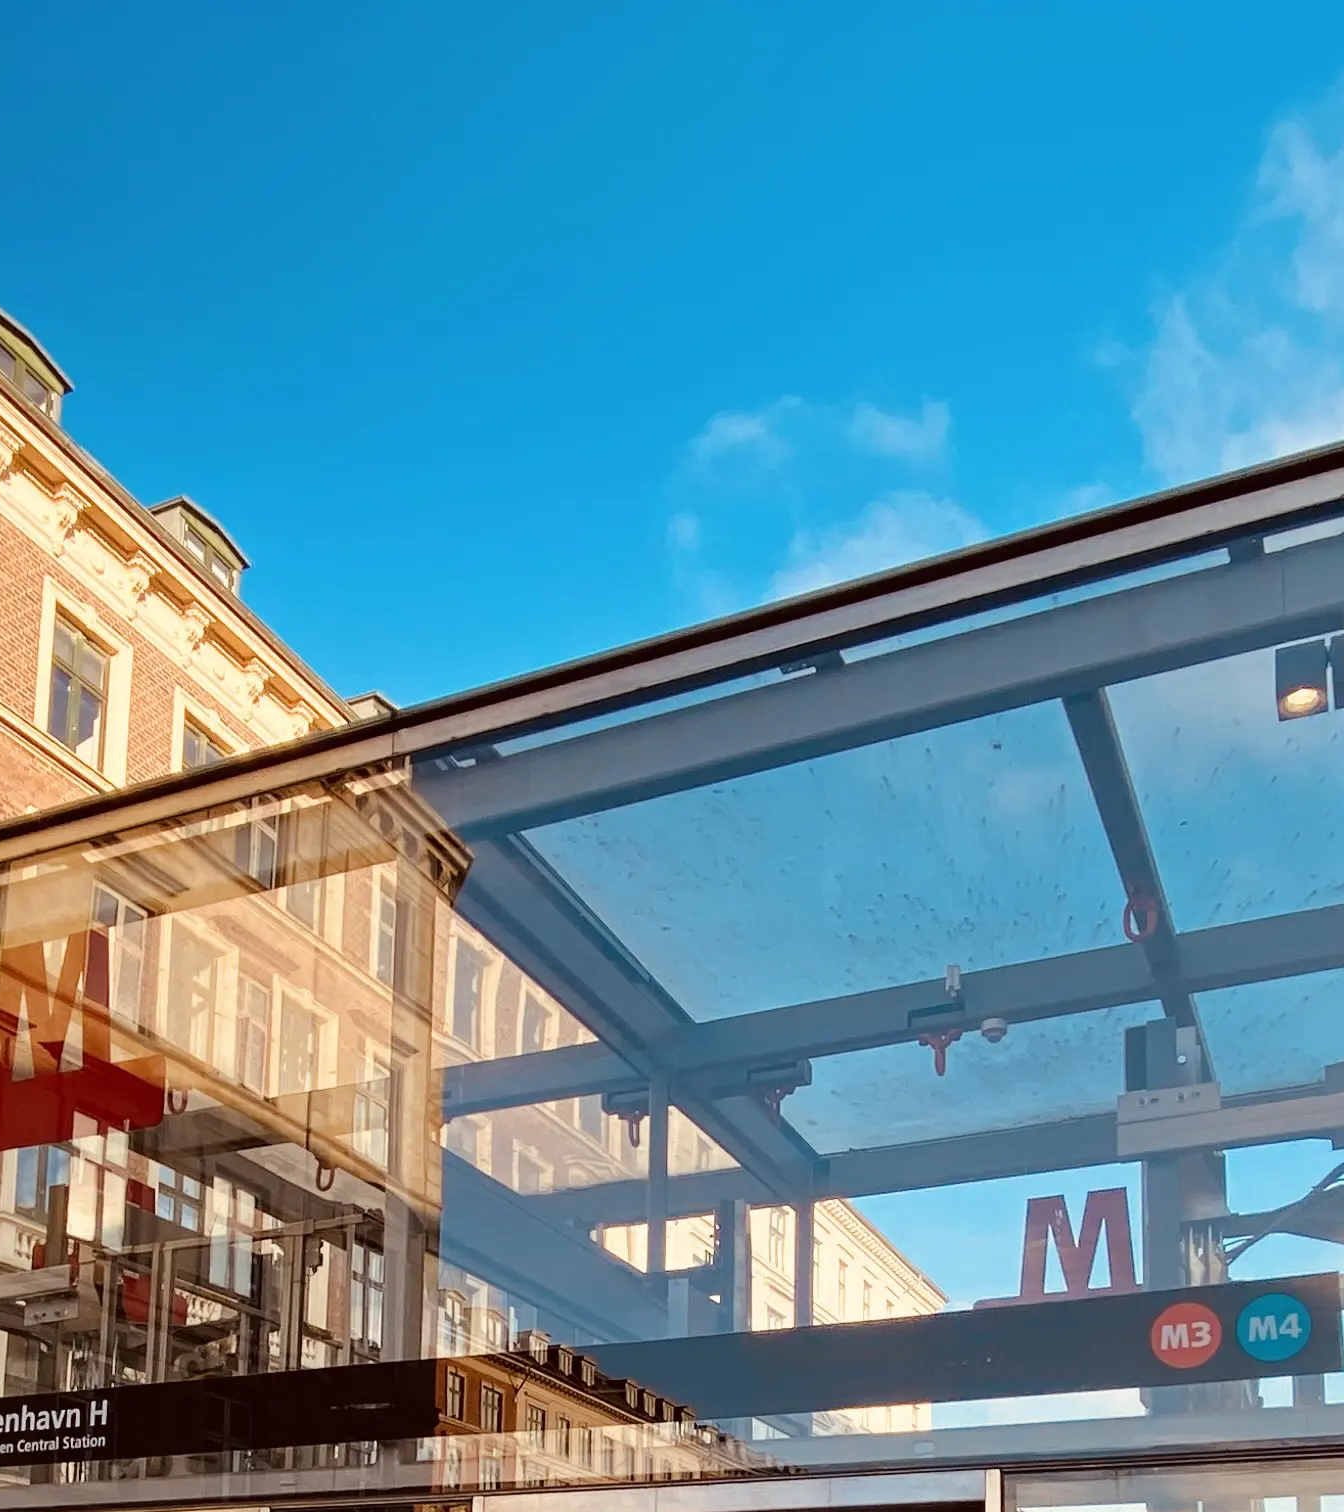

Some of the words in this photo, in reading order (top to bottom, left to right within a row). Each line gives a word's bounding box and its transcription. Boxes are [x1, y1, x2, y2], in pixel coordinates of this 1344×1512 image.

[1020, 1187, 1136, 1297] M
[1160, 1321, 1211, 1350] M3
[1248, 1313, 1302, 1342] M4
[89, 1400, 108, 1427] H
[16, 1436, 59, 1453] Central
[62, 1434, 106, 1449] Station
